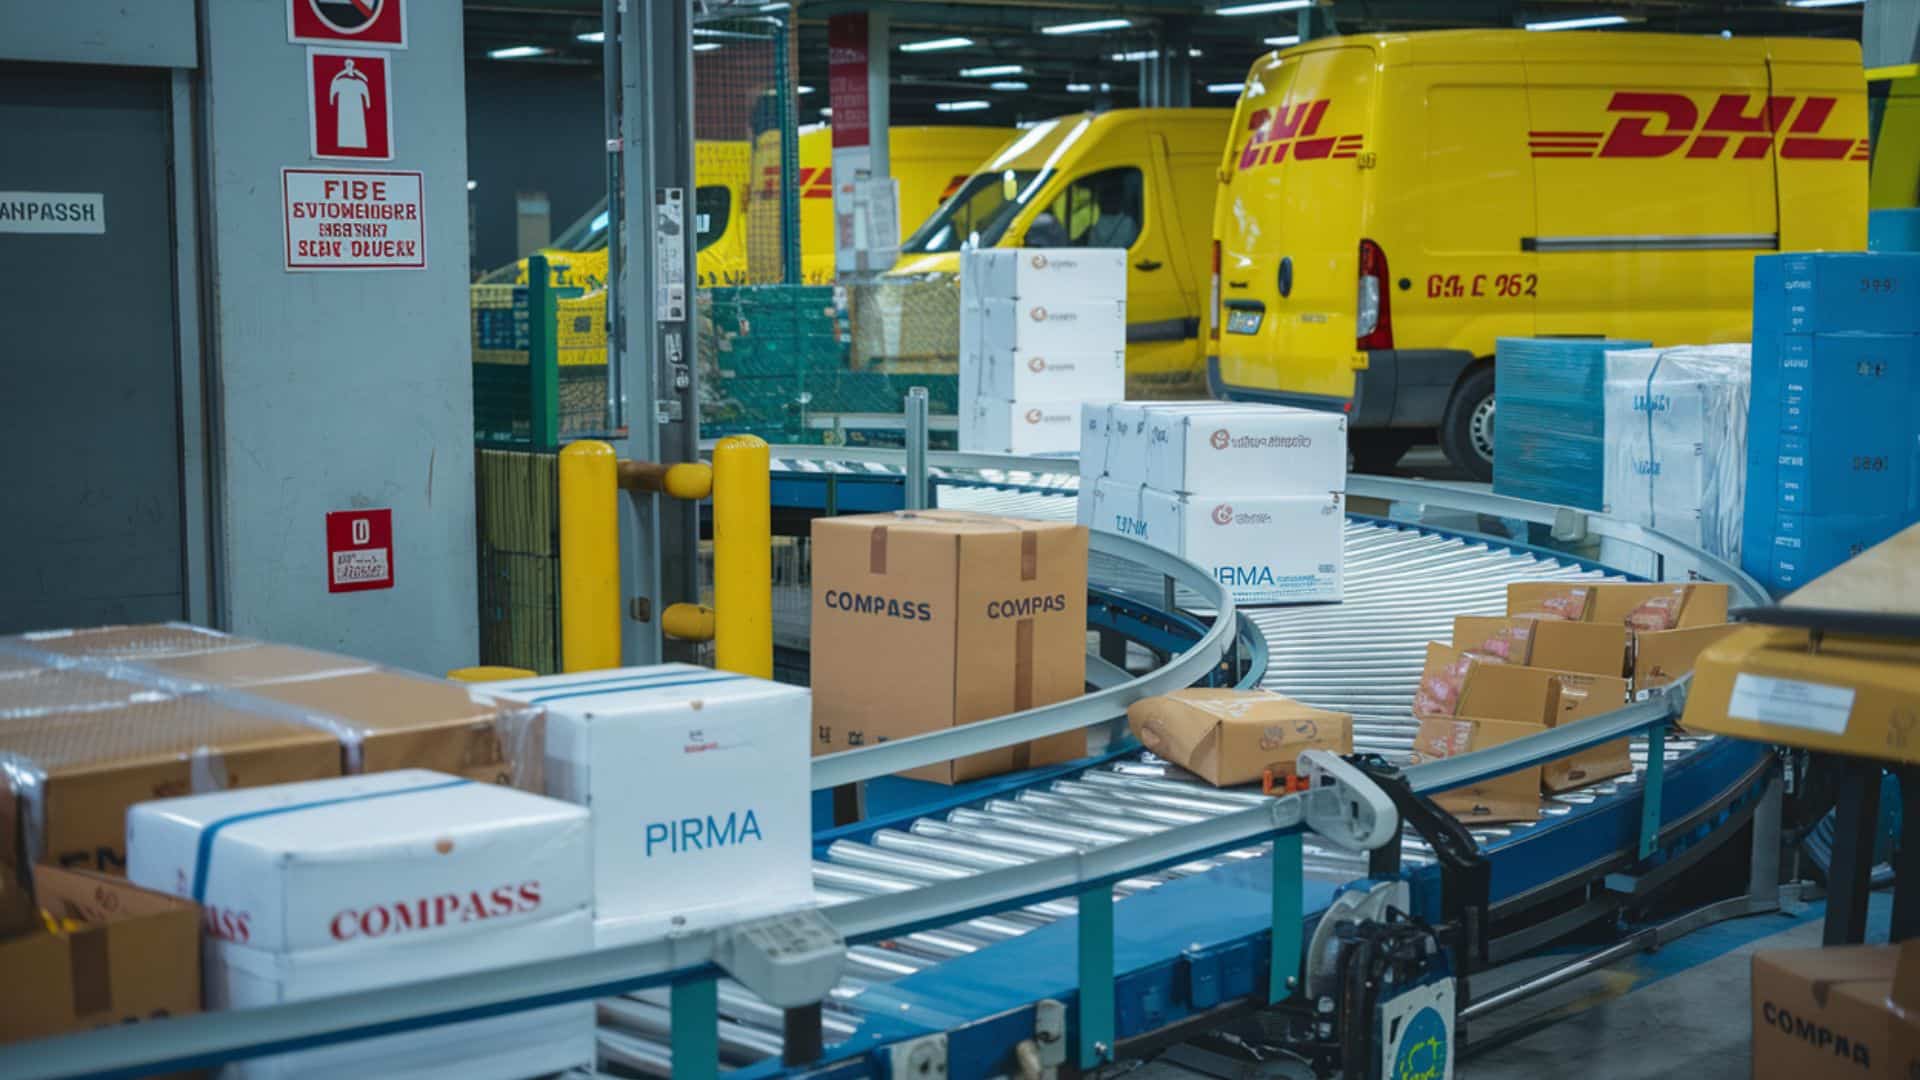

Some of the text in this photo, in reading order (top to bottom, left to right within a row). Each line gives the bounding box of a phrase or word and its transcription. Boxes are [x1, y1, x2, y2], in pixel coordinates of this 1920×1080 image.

[1239, 98, 1338, 170] DHL
[1598, 91, 1856, 160] DHL
[825, 590, 932, 622] COMPASS
[645, 809, 762, 857] PIRMA
[330, 881, 542, 942] COMPASS
